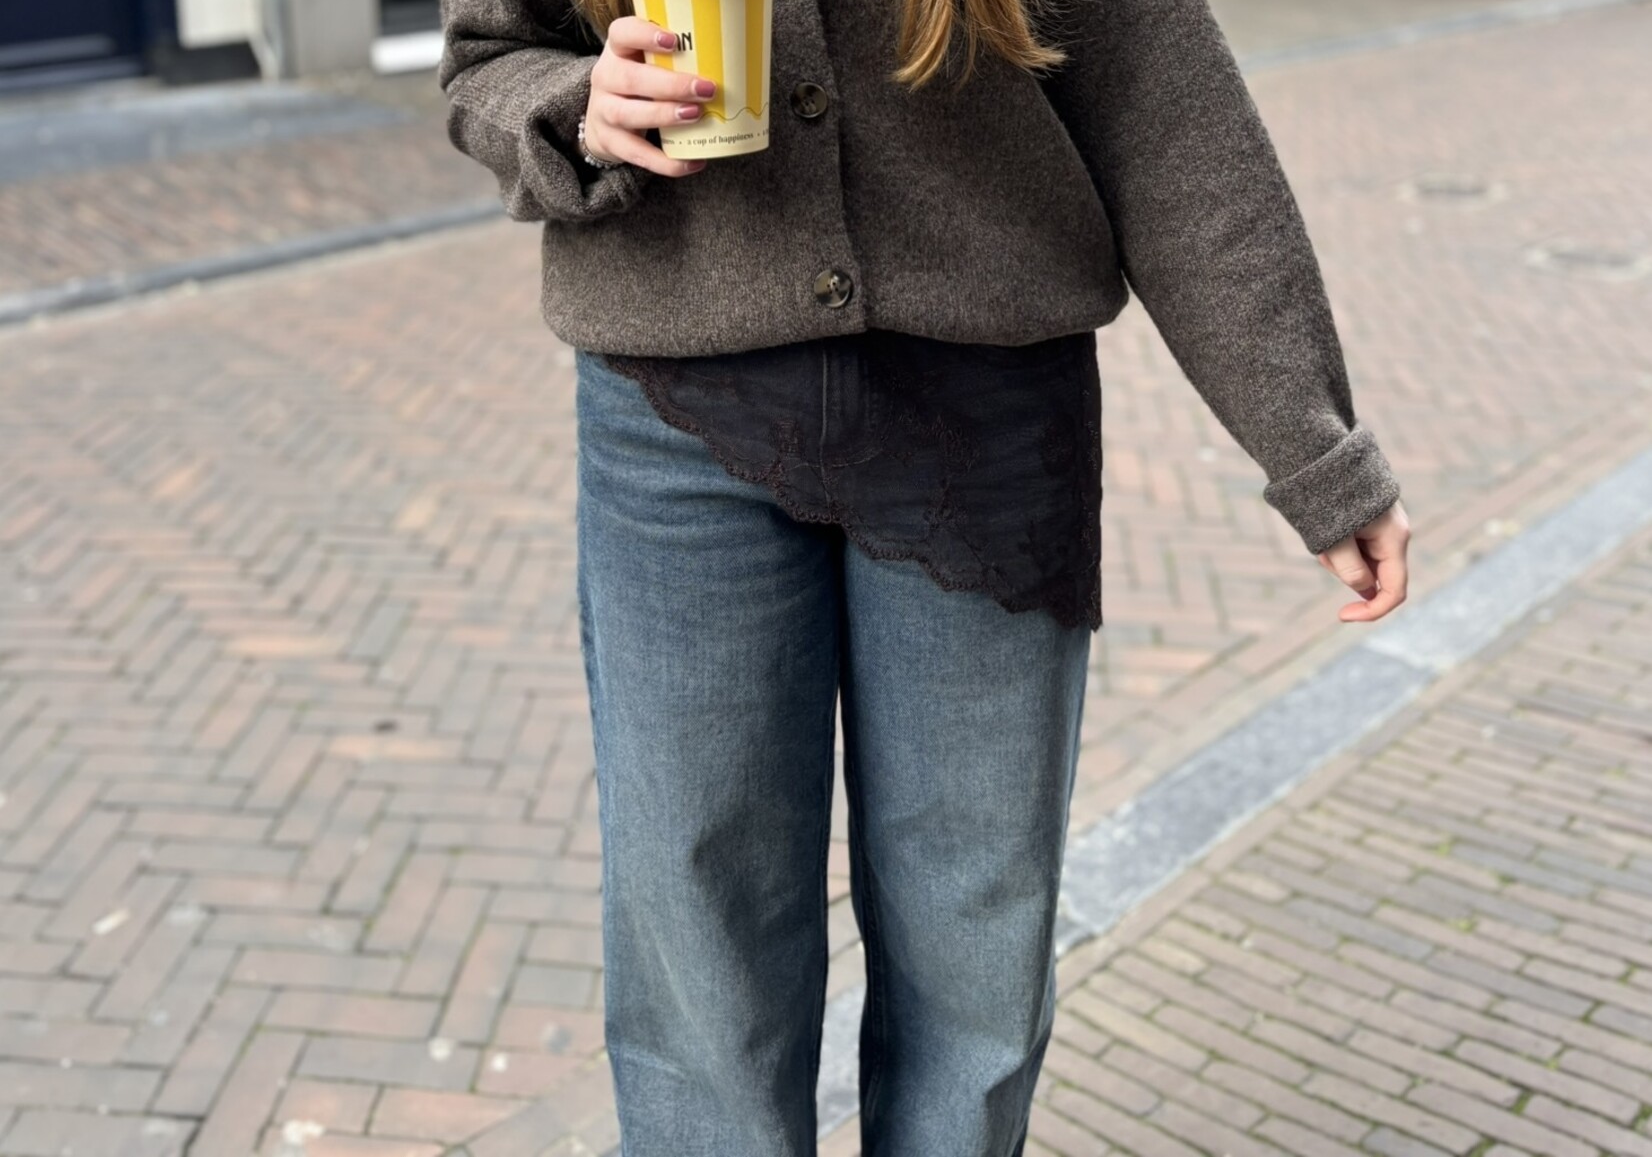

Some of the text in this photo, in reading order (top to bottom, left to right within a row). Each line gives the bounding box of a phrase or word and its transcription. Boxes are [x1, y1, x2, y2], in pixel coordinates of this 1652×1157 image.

[693, 138, 707, 146] cup
[709, 136, 718, 144] of
[718, 133, 754, 145] happiness
